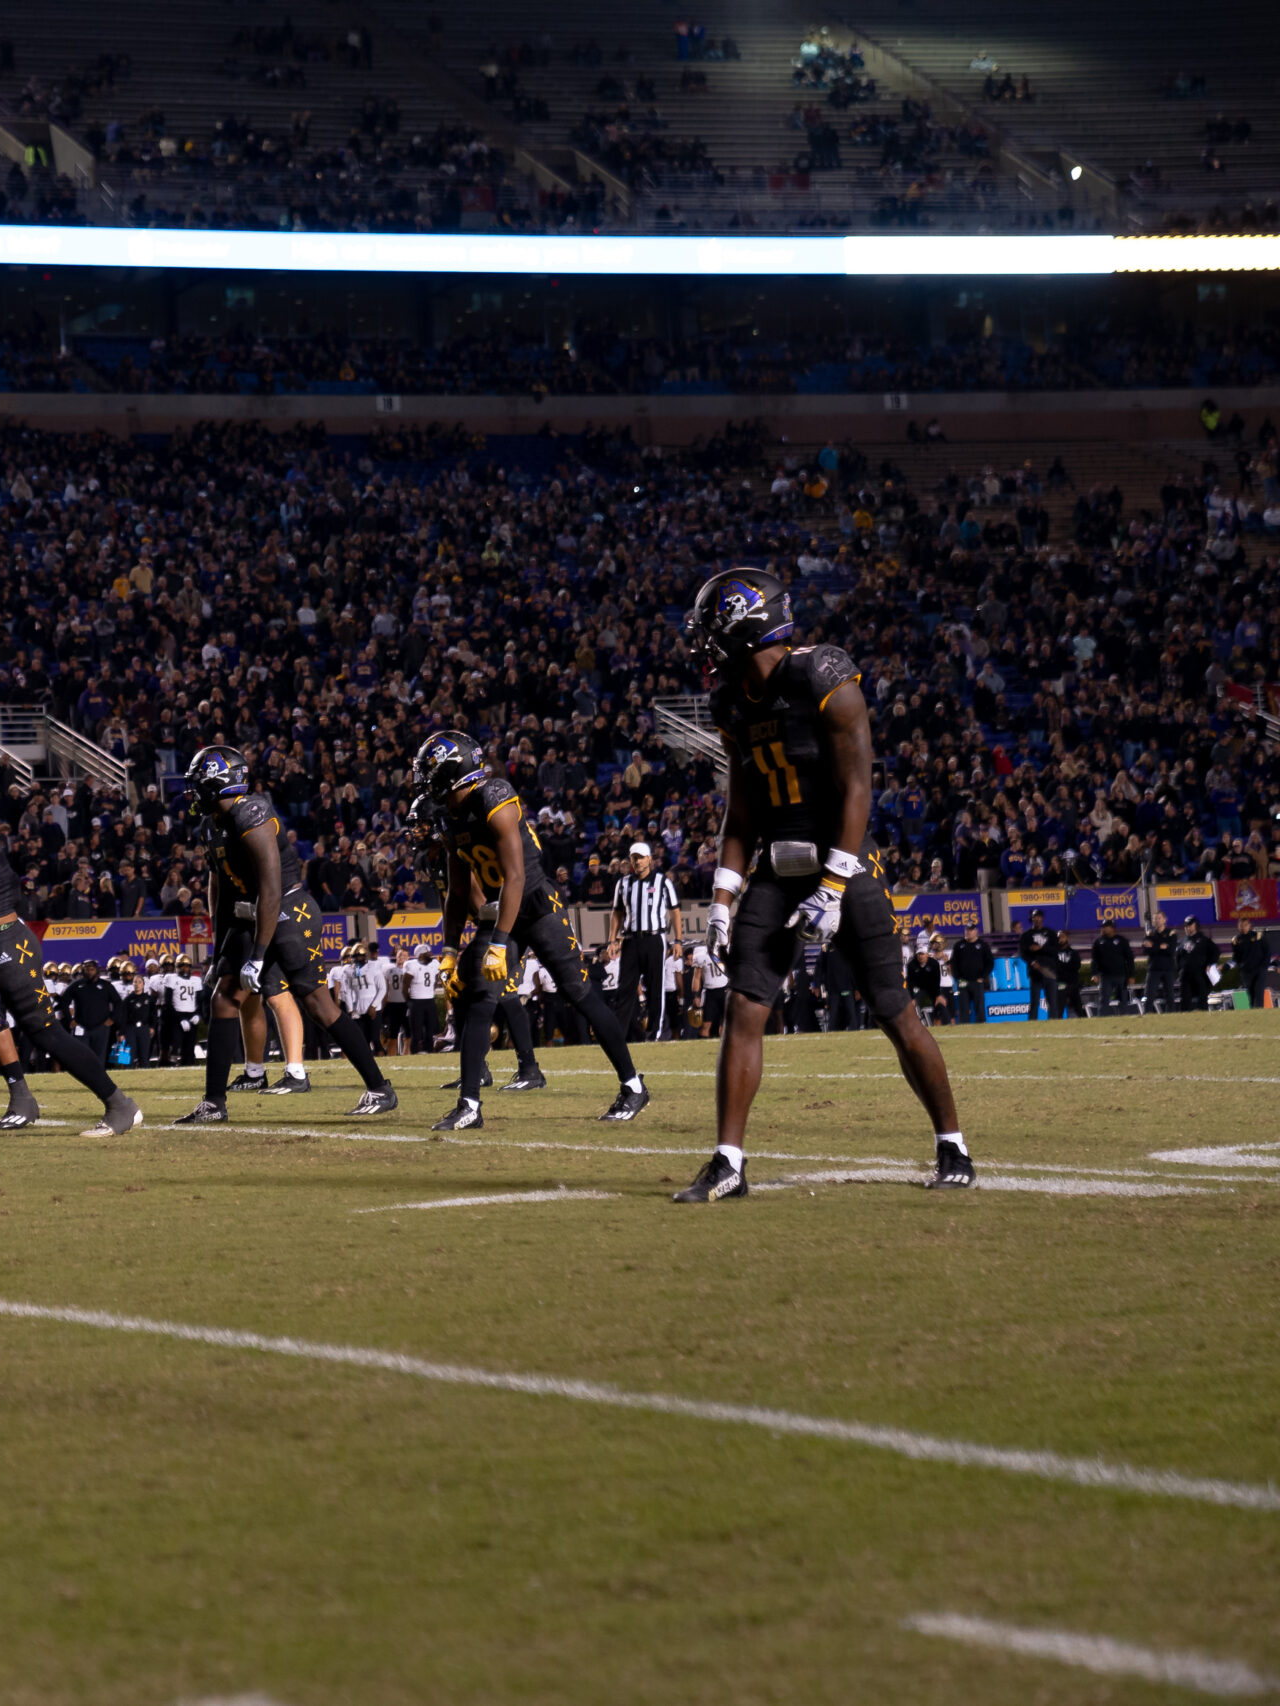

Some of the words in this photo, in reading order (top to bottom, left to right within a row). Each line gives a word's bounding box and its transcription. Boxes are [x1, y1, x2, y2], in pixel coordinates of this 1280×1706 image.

[751, 741, 803, 808] 11
[944, 900, 978, 912] BOWL
[1098, 894, 1134, 906] TERRY
[1096, 906, 1136, 920] LONG
[401, 916, 407, 924] 7
[51, 926, 97, 936] 1977-1980
[135, 928, 178, 941] WAYNE
[129, 942, 180, 957] INMAN
[424, 972, 431, 987] 8
[180, 986, 194, 1001] 24
